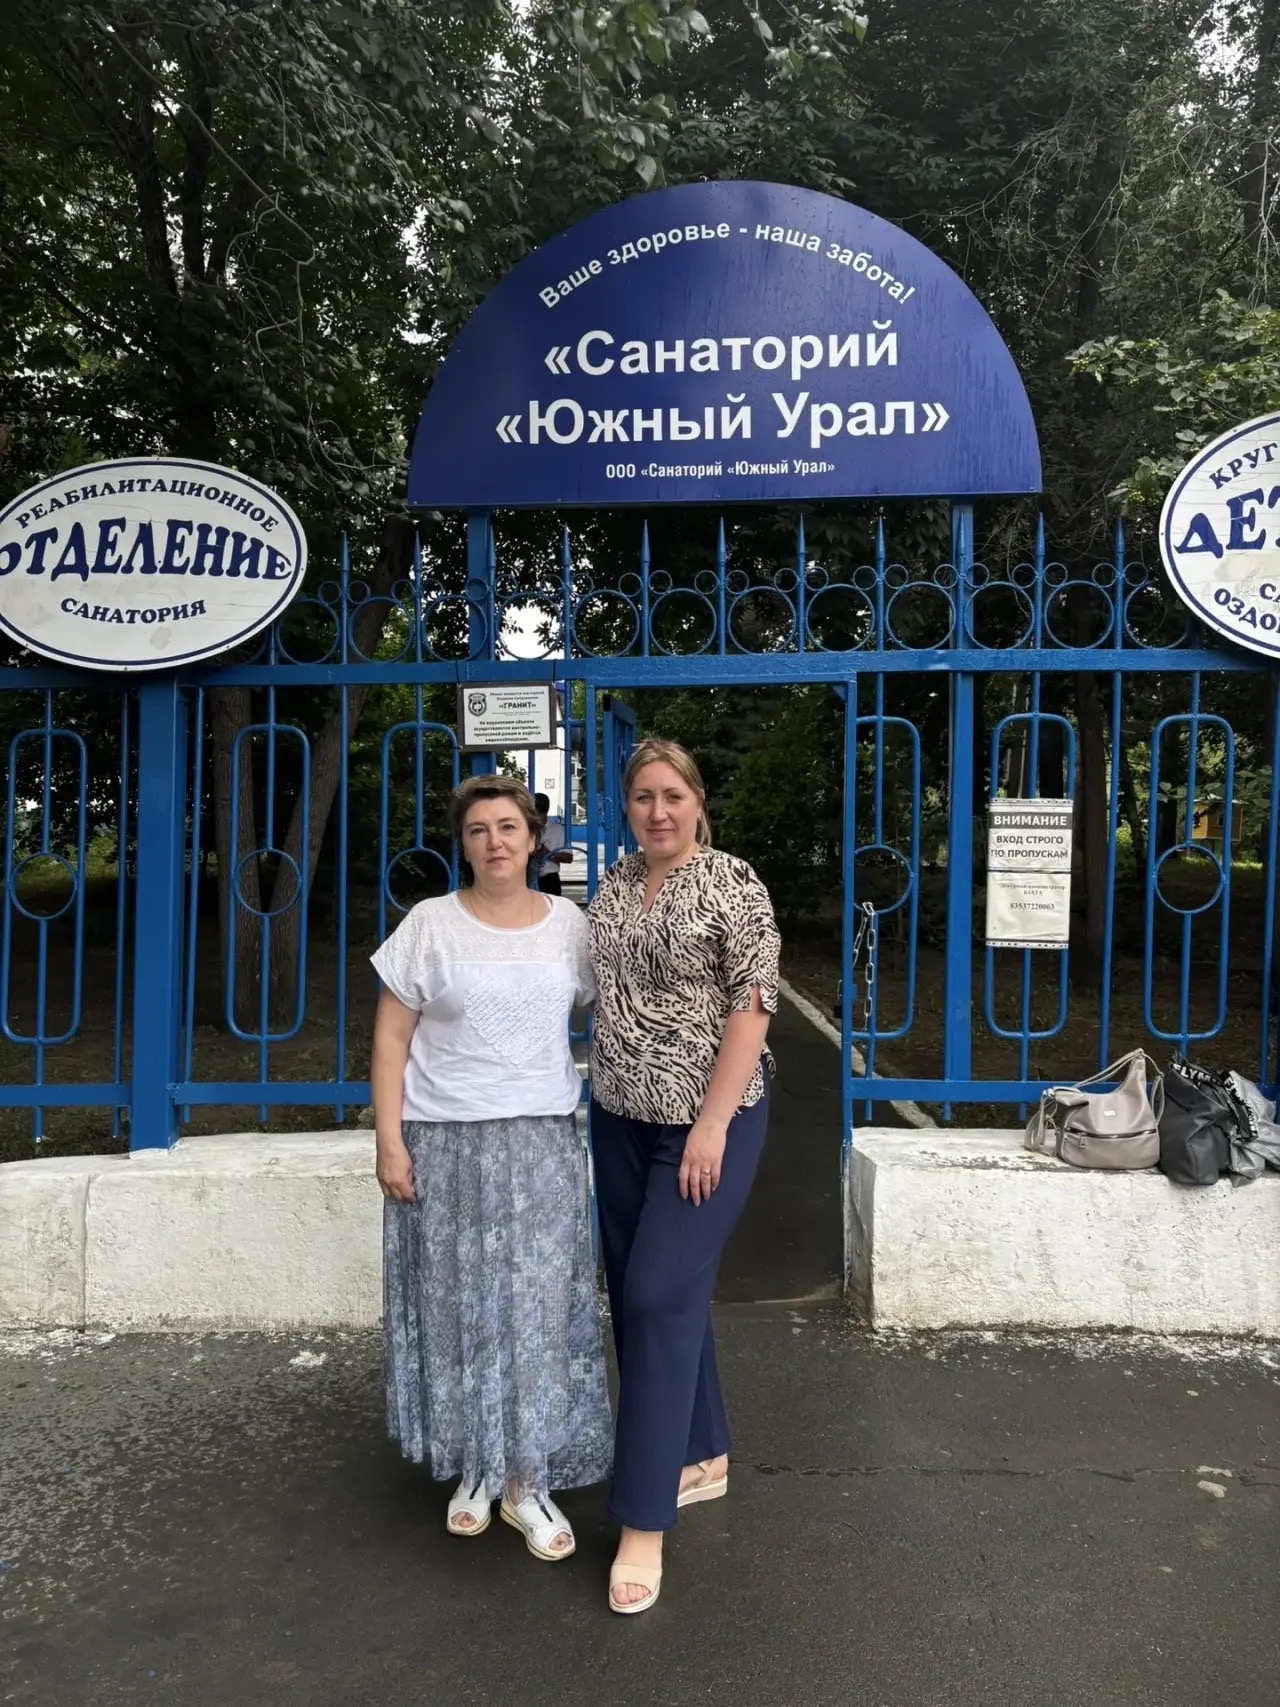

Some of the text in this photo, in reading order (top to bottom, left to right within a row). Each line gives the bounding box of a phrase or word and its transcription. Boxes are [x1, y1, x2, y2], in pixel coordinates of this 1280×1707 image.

[538, 258, 603, 309] Ваше
[608, 222, 731, 266] здоровье
[755, 224, 822, 253] наша
[825, 243, 915, 305] забота!
[544, 319, 898, 381] «Санаторий
[495, 392, 950, 449] «Южный Урал»
[605, 459, 835, 480] ООО «Санаторий «Южный Урал»
[1208, 442, 1278, 490] КРУГ
[15, 478, 279, 533] РЕАБИЛИТАЦИОННОЕ
[0, 516, 293, 582] ОТДЕЛЕНИЕ
[60, 597, 207, 624] САНАТОРИЯ
[1213, 588, 1280, 634] ОЗДО
[993, 815, 1068, 826] ВНИМАНИЕ
[996, 835, 1064, 845] ВХОД СТРОГО
[990, 849, 1069, 859] ПО ПРОПУСКАМ
